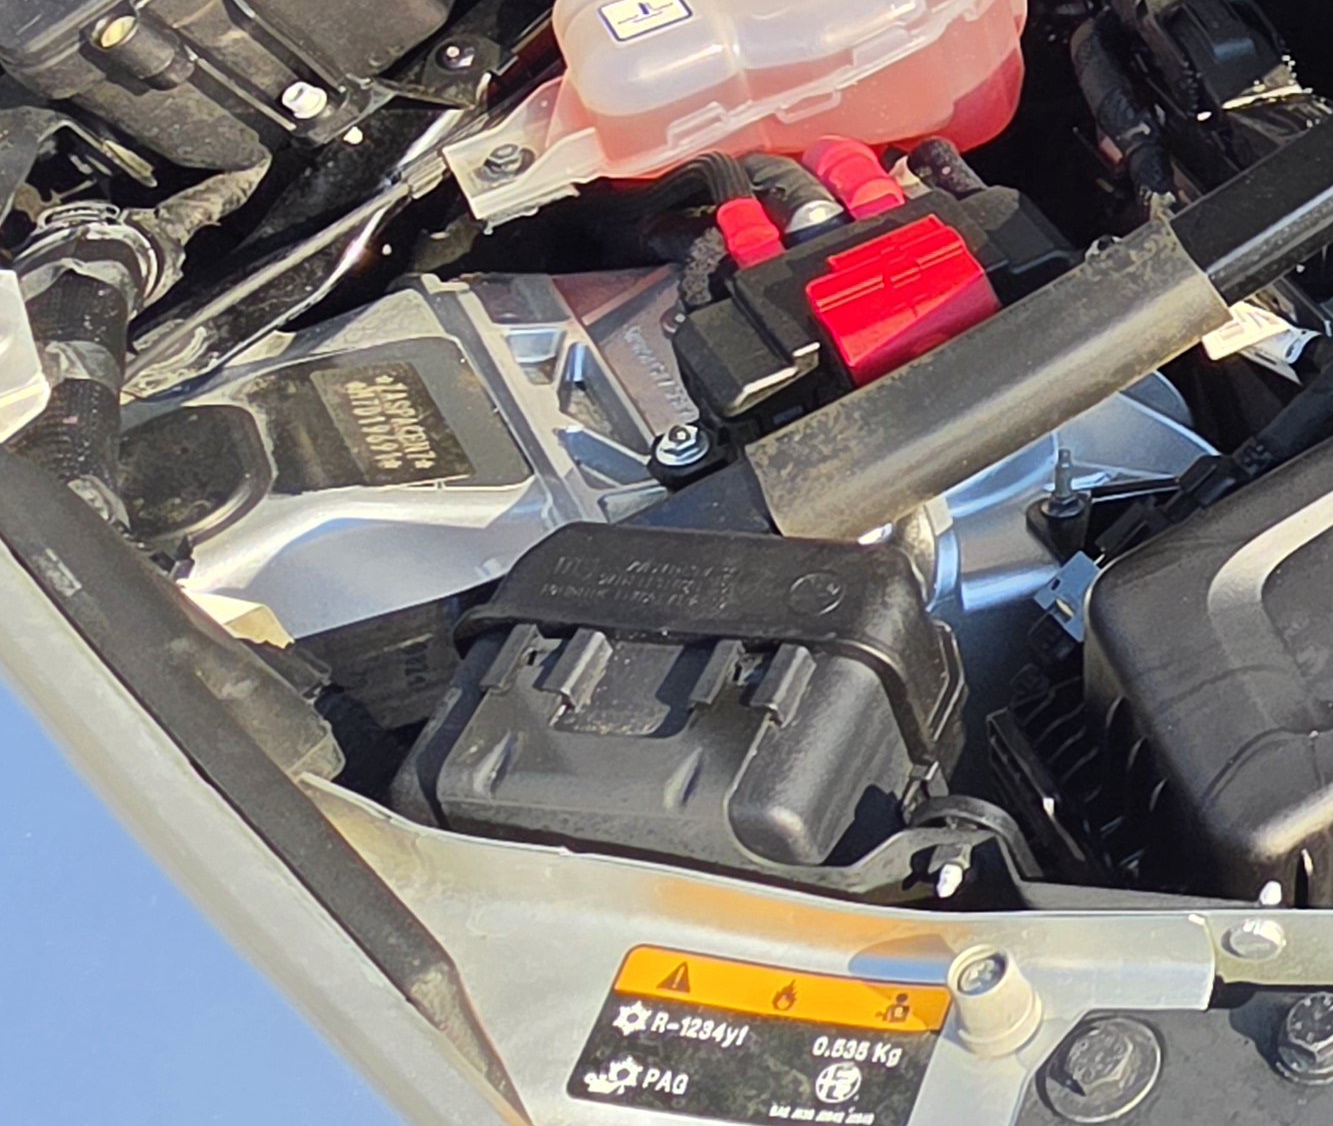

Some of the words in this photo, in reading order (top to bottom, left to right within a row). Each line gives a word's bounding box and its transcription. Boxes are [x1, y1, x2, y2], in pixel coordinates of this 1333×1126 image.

[651, 1011, 749, 1048] R-1234yf
[812, 1036, 870, 1061] 0.535
[872, 1042, 903, 1068] Kg
